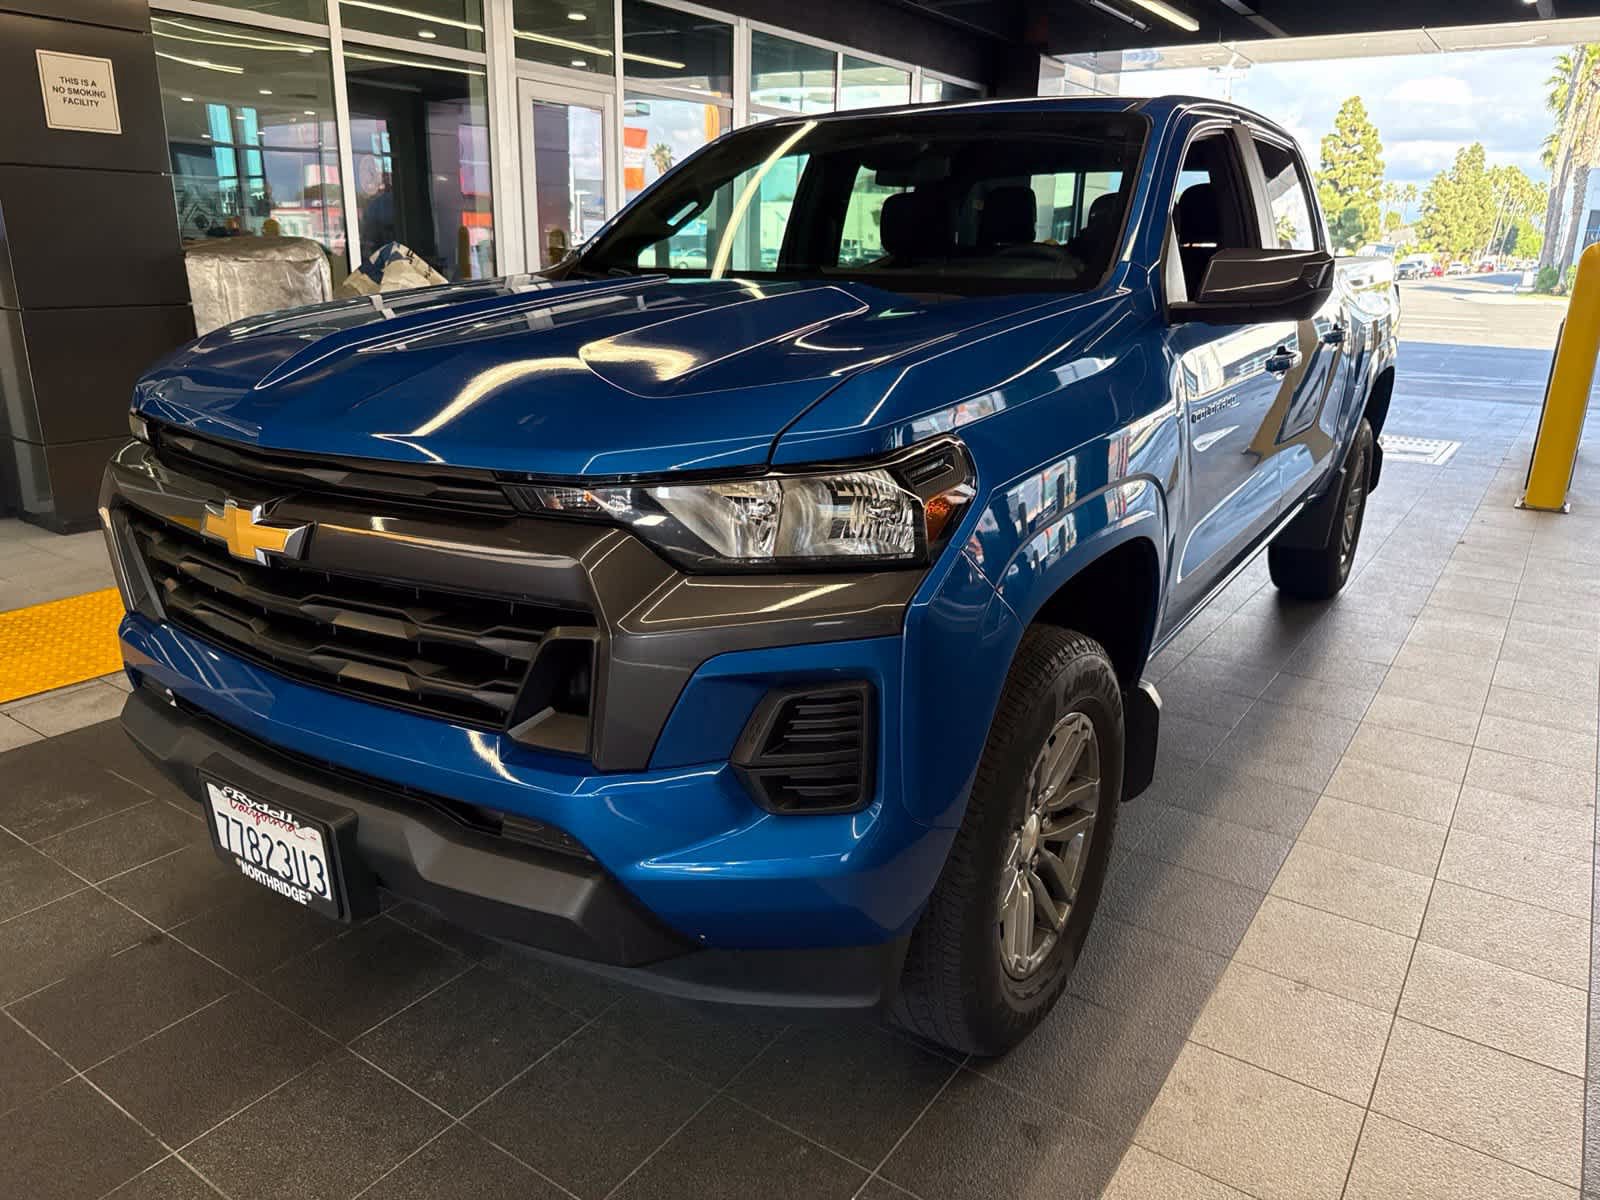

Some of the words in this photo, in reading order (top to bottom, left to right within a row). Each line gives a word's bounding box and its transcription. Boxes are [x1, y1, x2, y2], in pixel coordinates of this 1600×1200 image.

[60, 76, 79, 86] THIS
[91, 80, 97, 88] A
[52, 86, 66, 94] NO
[67, 87, 106, 99] SMOKING
[63, 97, 100, 108] FACILITY
[217, 811, 328, 897] 77823U3
[241, 861, 308, 905] NORTHRIDGE
